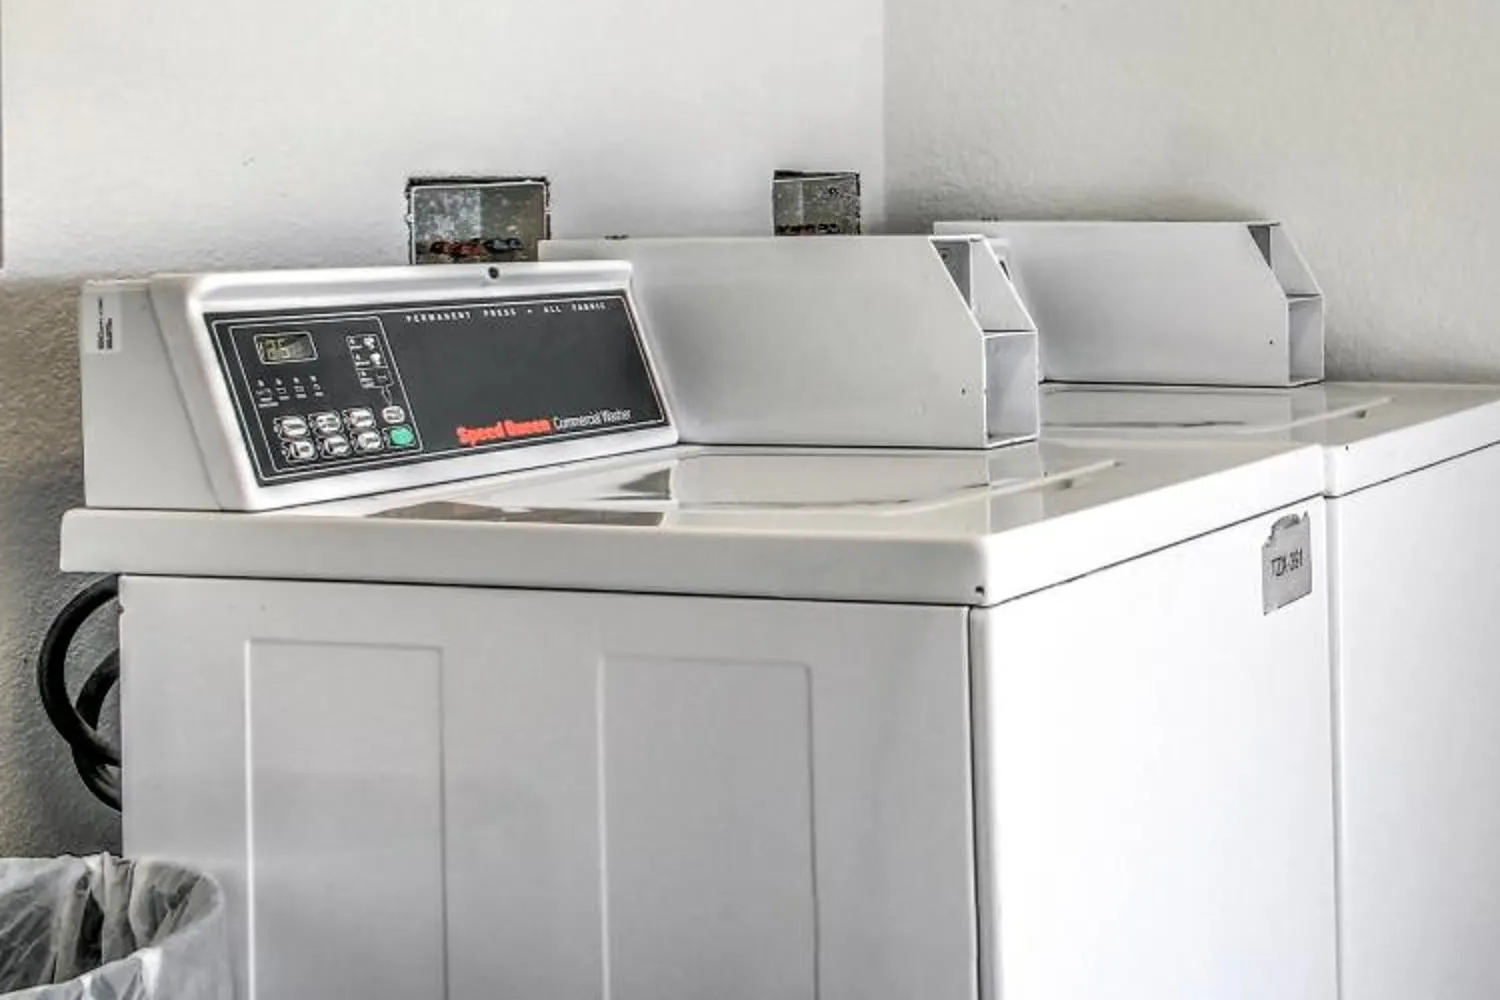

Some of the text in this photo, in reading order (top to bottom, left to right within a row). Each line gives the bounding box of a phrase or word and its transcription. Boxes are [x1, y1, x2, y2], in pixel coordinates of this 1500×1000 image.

[405, 311, 471, 323] PERMANENT
[483, 307, 517, 317] PRESS
[543, 304, 562, 313] ALL
[457, 409, 631, 447] Speed Queen Commercial Washer
